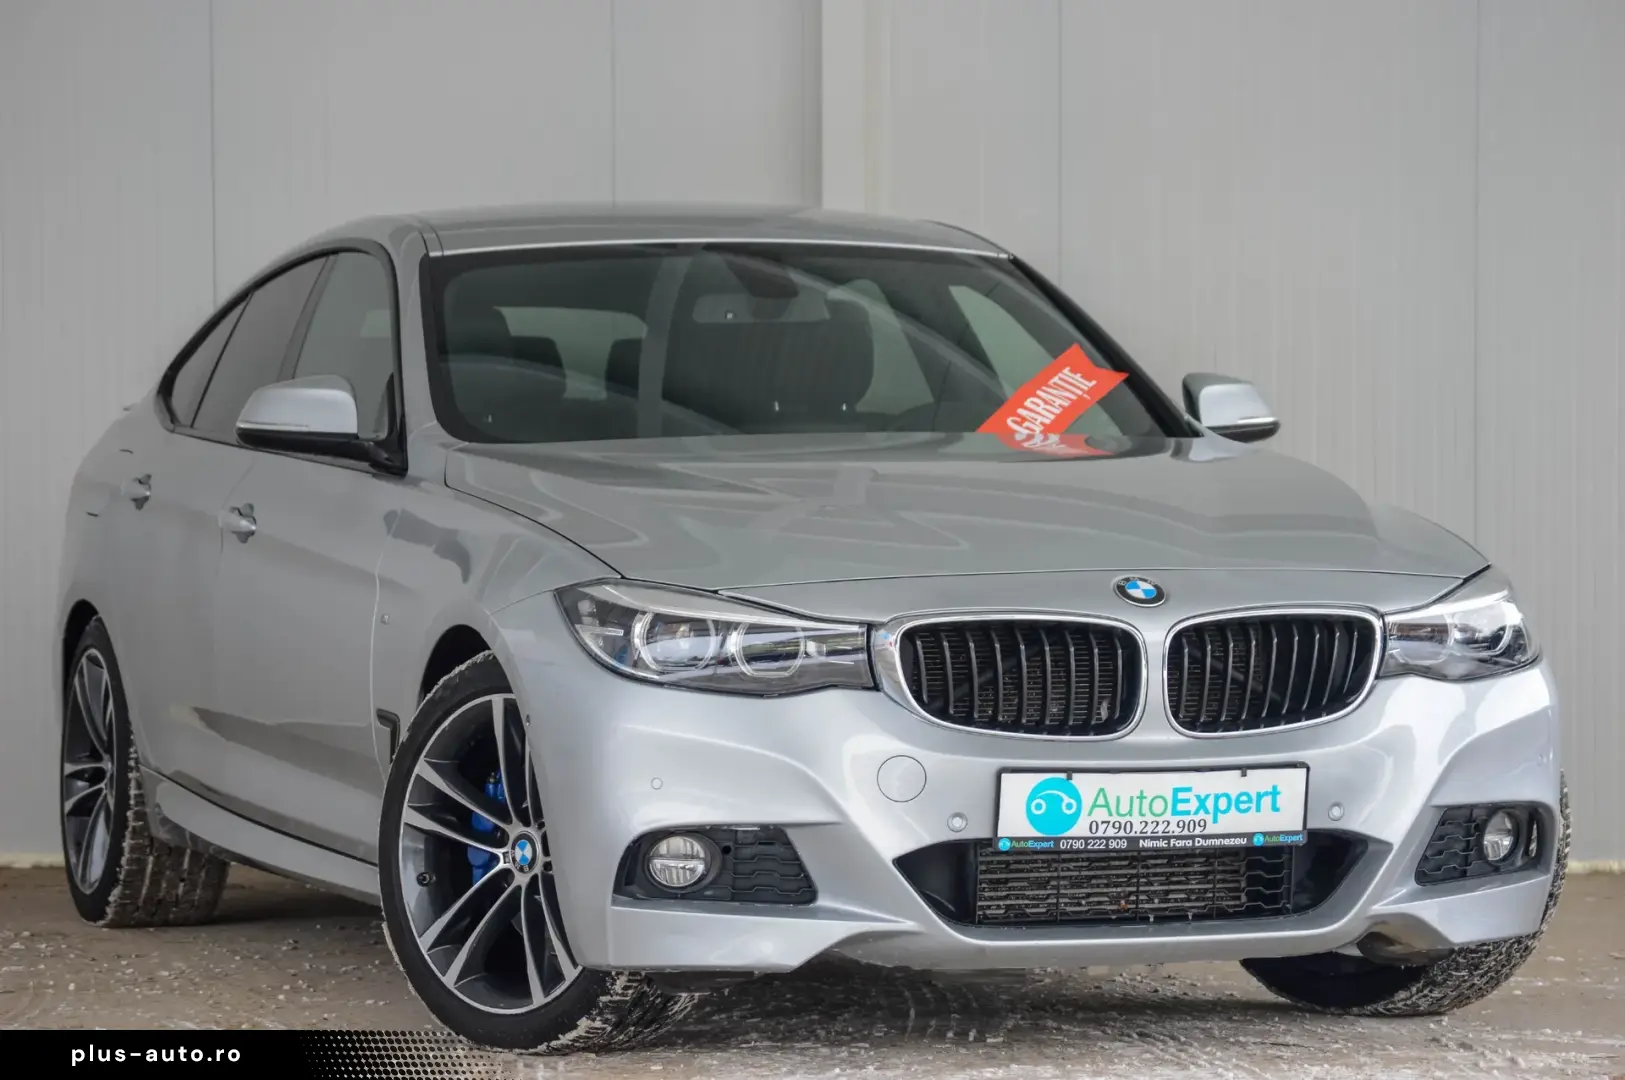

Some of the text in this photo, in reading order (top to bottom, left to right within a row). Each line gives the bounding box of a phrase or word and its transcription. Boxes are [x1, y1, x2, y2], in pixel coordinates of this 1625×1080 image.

[1087, 784, 1281, 824] AutoExpert
[1089, 818, 1207, 835] 0790.222.909
[1011, 839, 1055, 850] AutoExpert
[1059, 839, 1085, 850] 0790
[1087, 839, 1107, 850] 222
[1108, 839, 1128, 849] 909
[1139, 838, 1168, 848] Nimic
[1170, 838, 1193, 847] Fara
[1194, 836, 1247, 847] Dumnezeu
